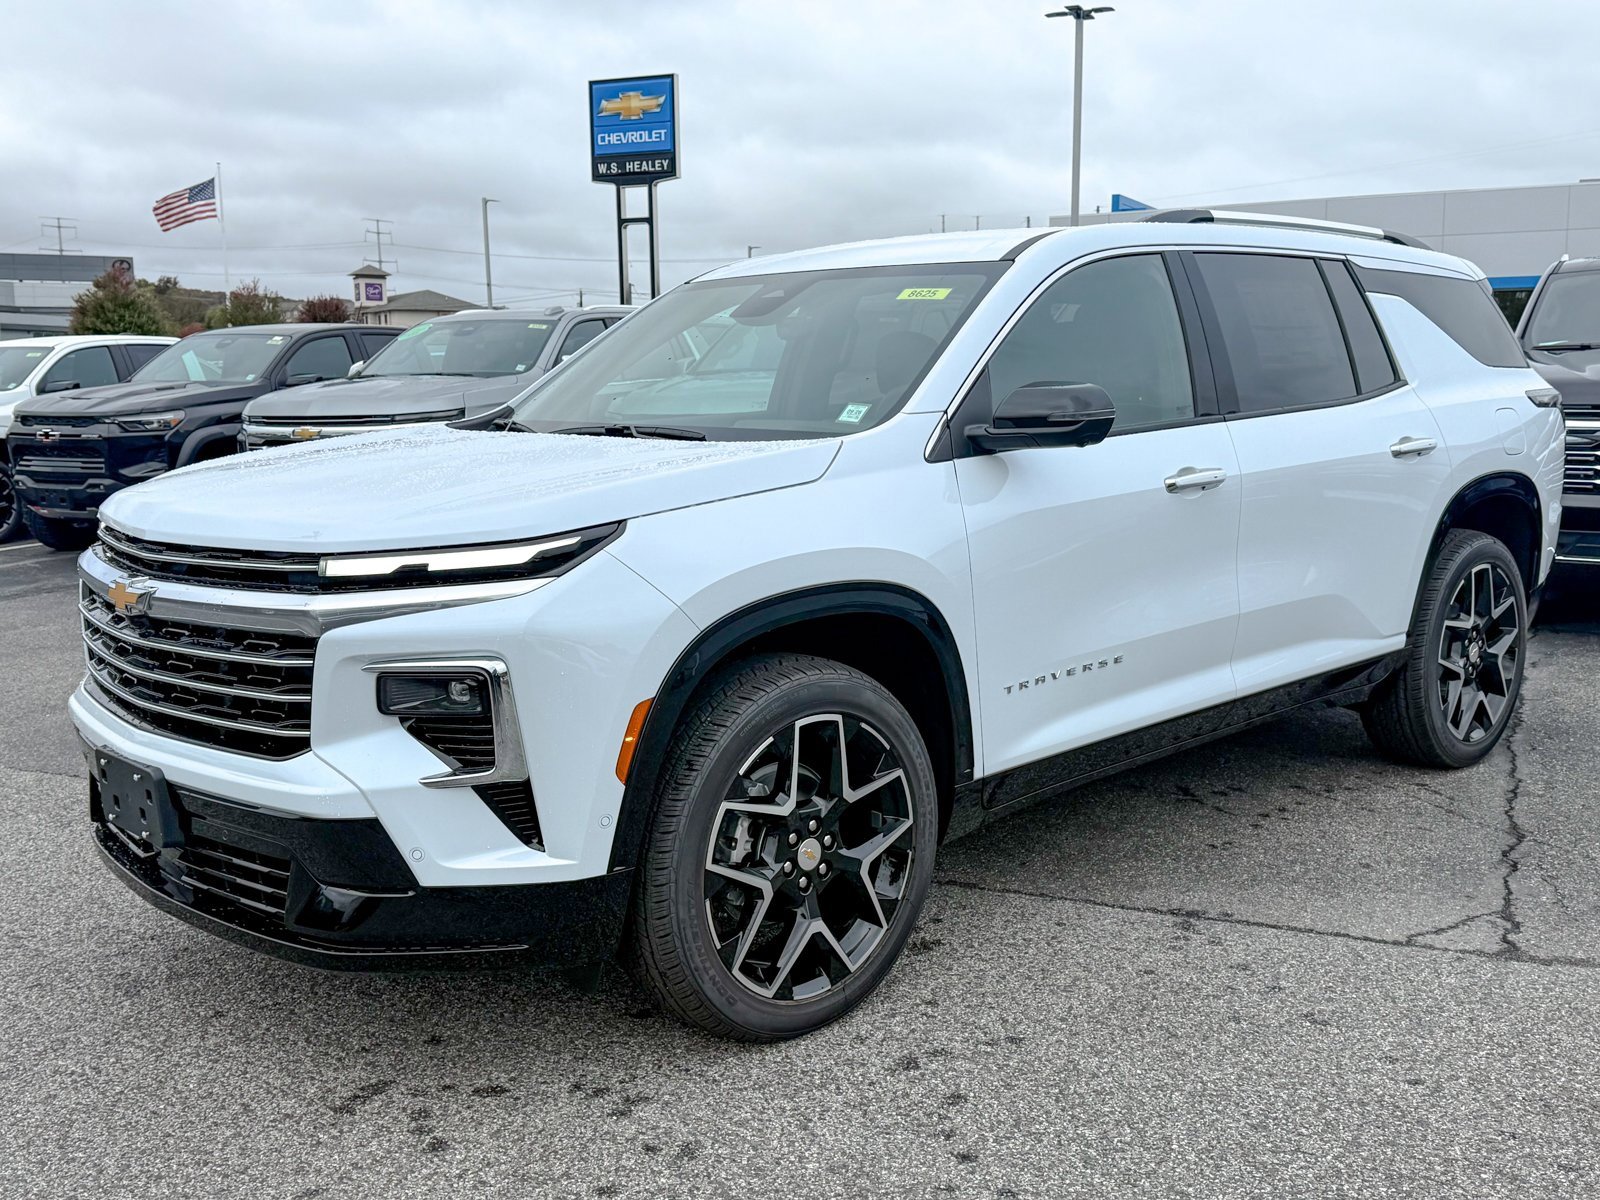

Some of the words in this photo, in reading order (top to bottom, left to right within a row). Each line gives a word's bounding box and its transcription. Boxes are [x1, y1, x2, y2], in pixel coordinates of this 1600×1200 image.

[597, 129, 667, 145] CHEVROLET
[597, 163, 622, 174] W.S.
[625, 159, 669, 172] HEALEY
[1003, 654, 1124, 695] TRAVERSE
